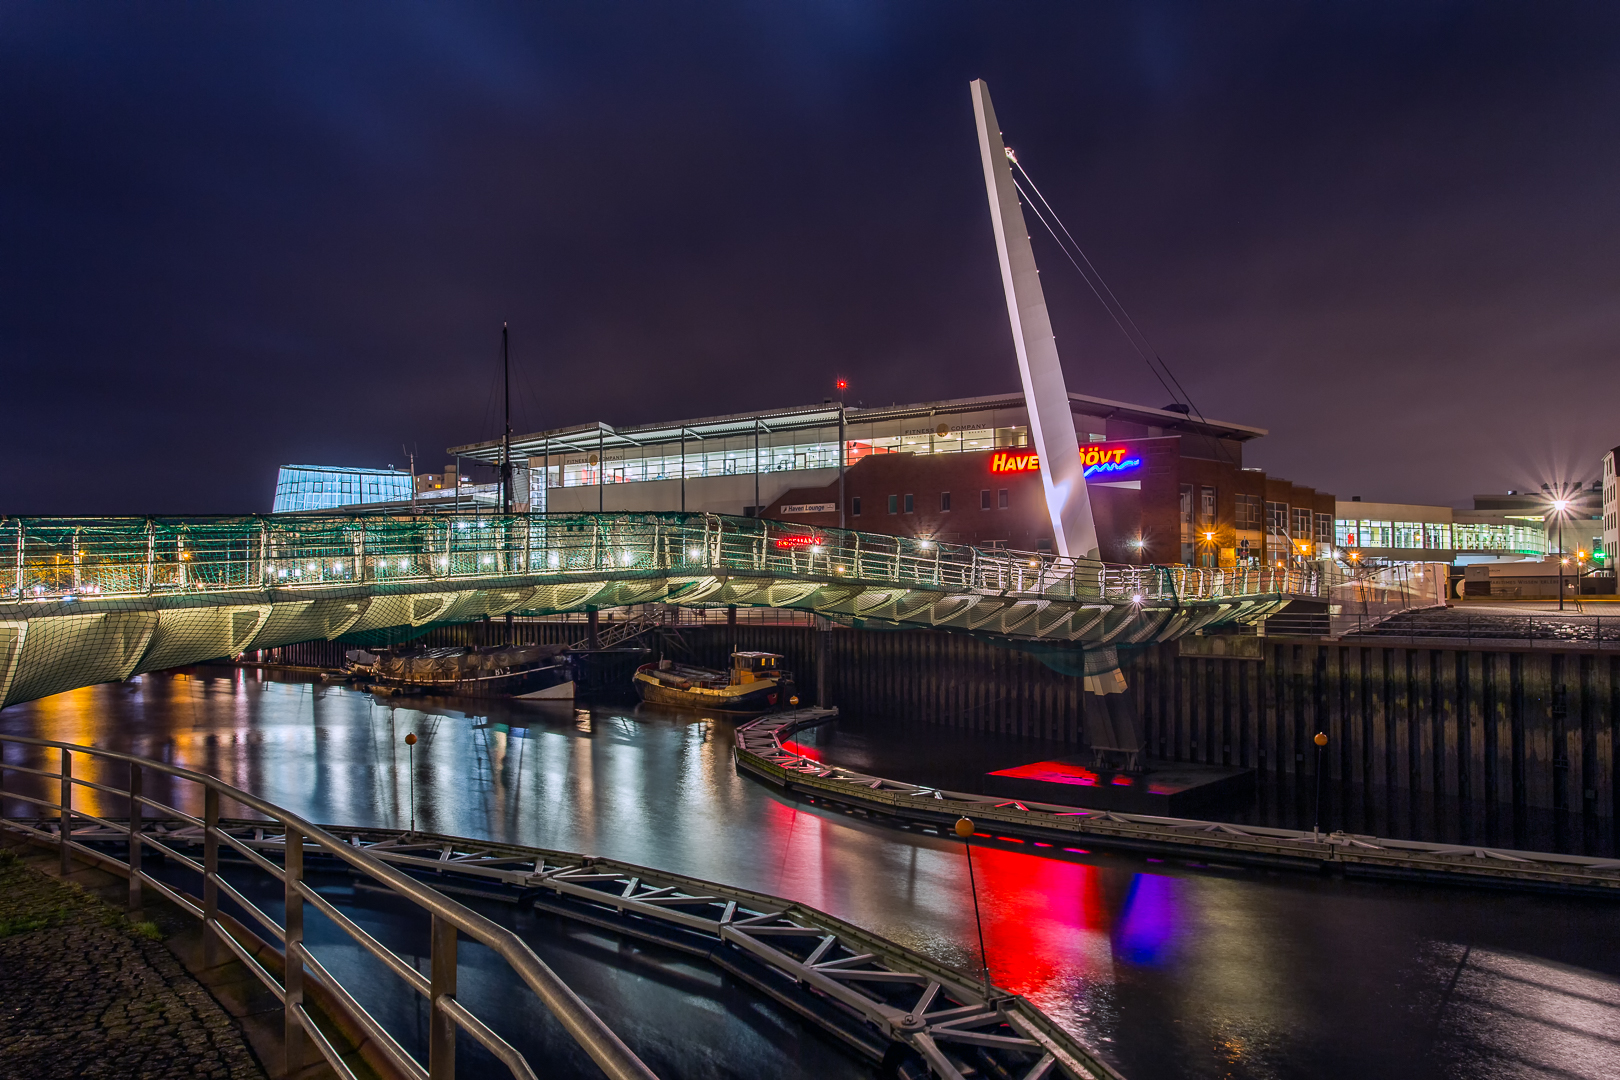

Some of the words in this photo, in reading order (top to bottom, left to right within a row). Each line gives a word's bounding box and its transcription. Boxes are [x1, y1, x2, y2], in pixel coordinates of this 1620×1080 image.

[905, 427, 935, 435] FITNESS
[950, 423, 986, 431] COMPANY
[992, 453, 1041, 472] HAVE
